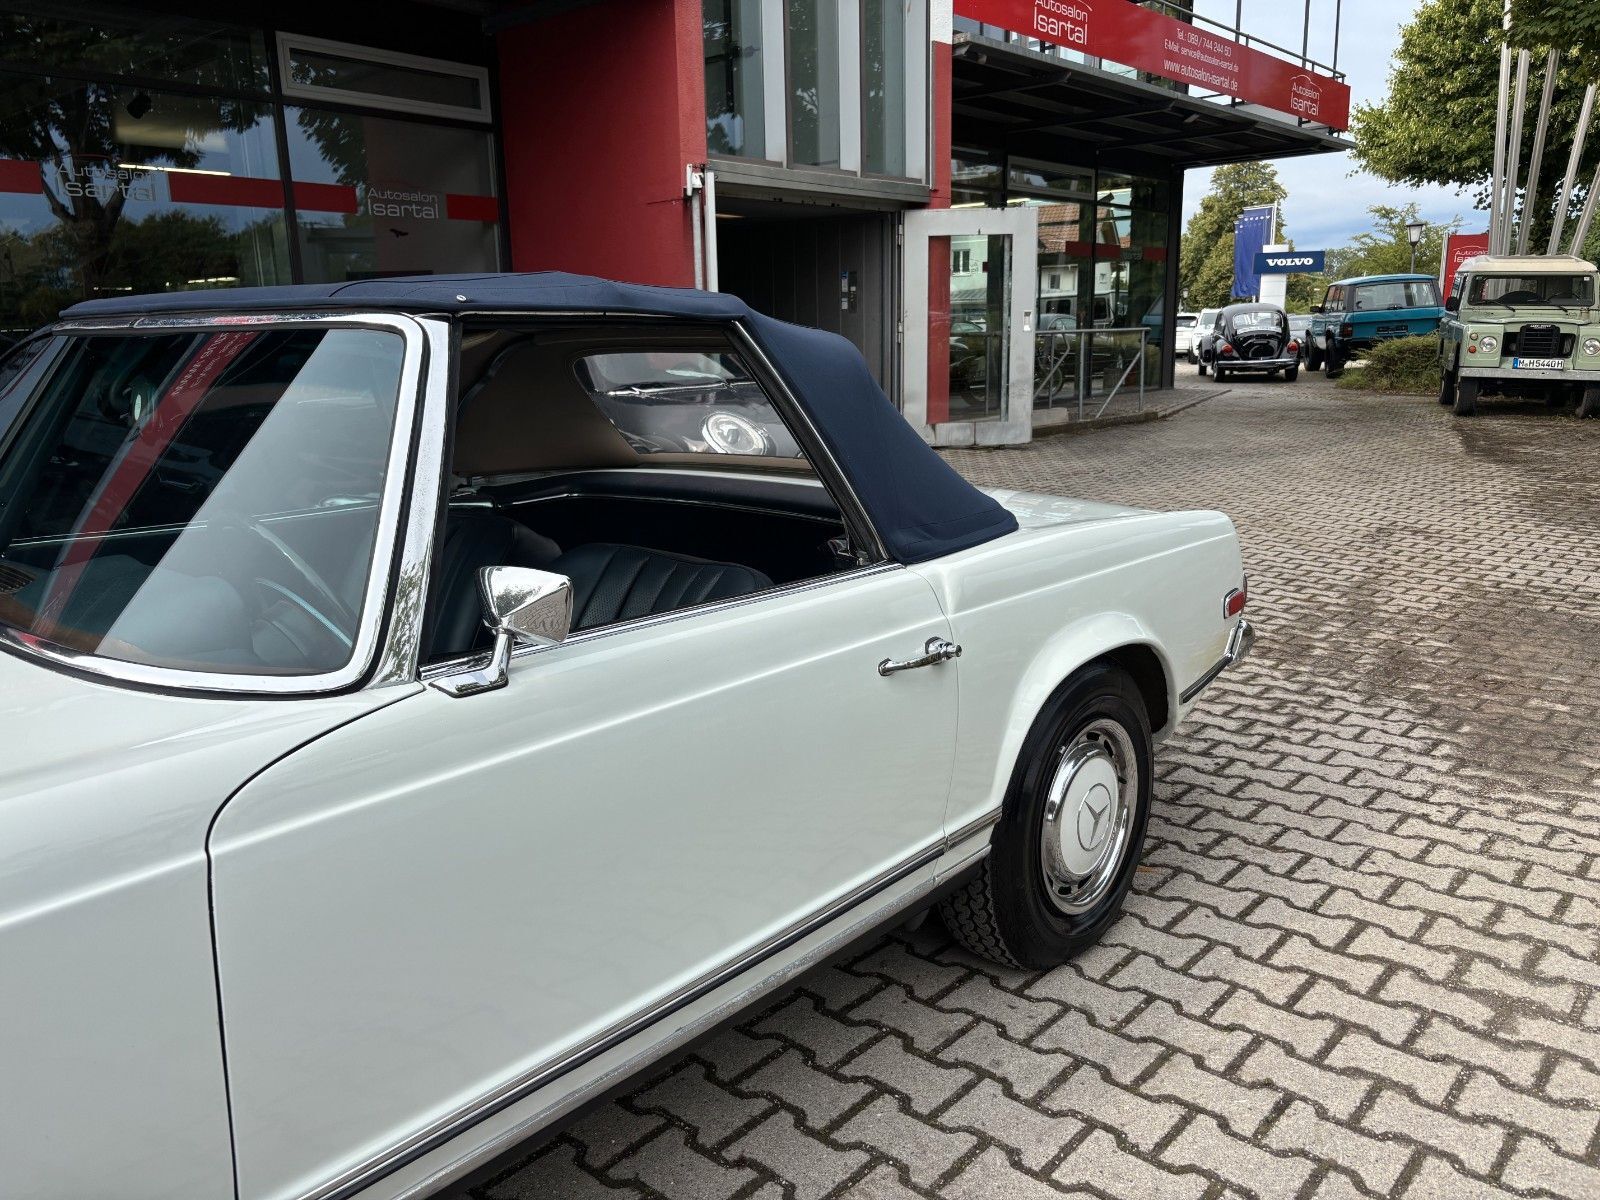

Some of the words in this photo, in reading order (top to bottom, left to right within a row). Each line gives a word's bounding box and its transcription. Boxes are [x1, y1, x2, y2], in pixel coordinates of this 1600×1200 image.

[1033, 6, 1088, 45] Isartal
[1187, 32, 1199, 46] 089
[1203, 37, 1213, 50] 744
[1213, 41, 1224, 54] 244
[1163, 59, 1238, 91] www.autosalon-isartal.de
[1292, 82, 1320, 100] Autosalon
[1290, 91, 1320, 116] Isartal
[368, 187, 438, 203] Autosalon
[367, 199, 439, 219] Isartal
[1266, 257, 1314, 267] VOLVO
